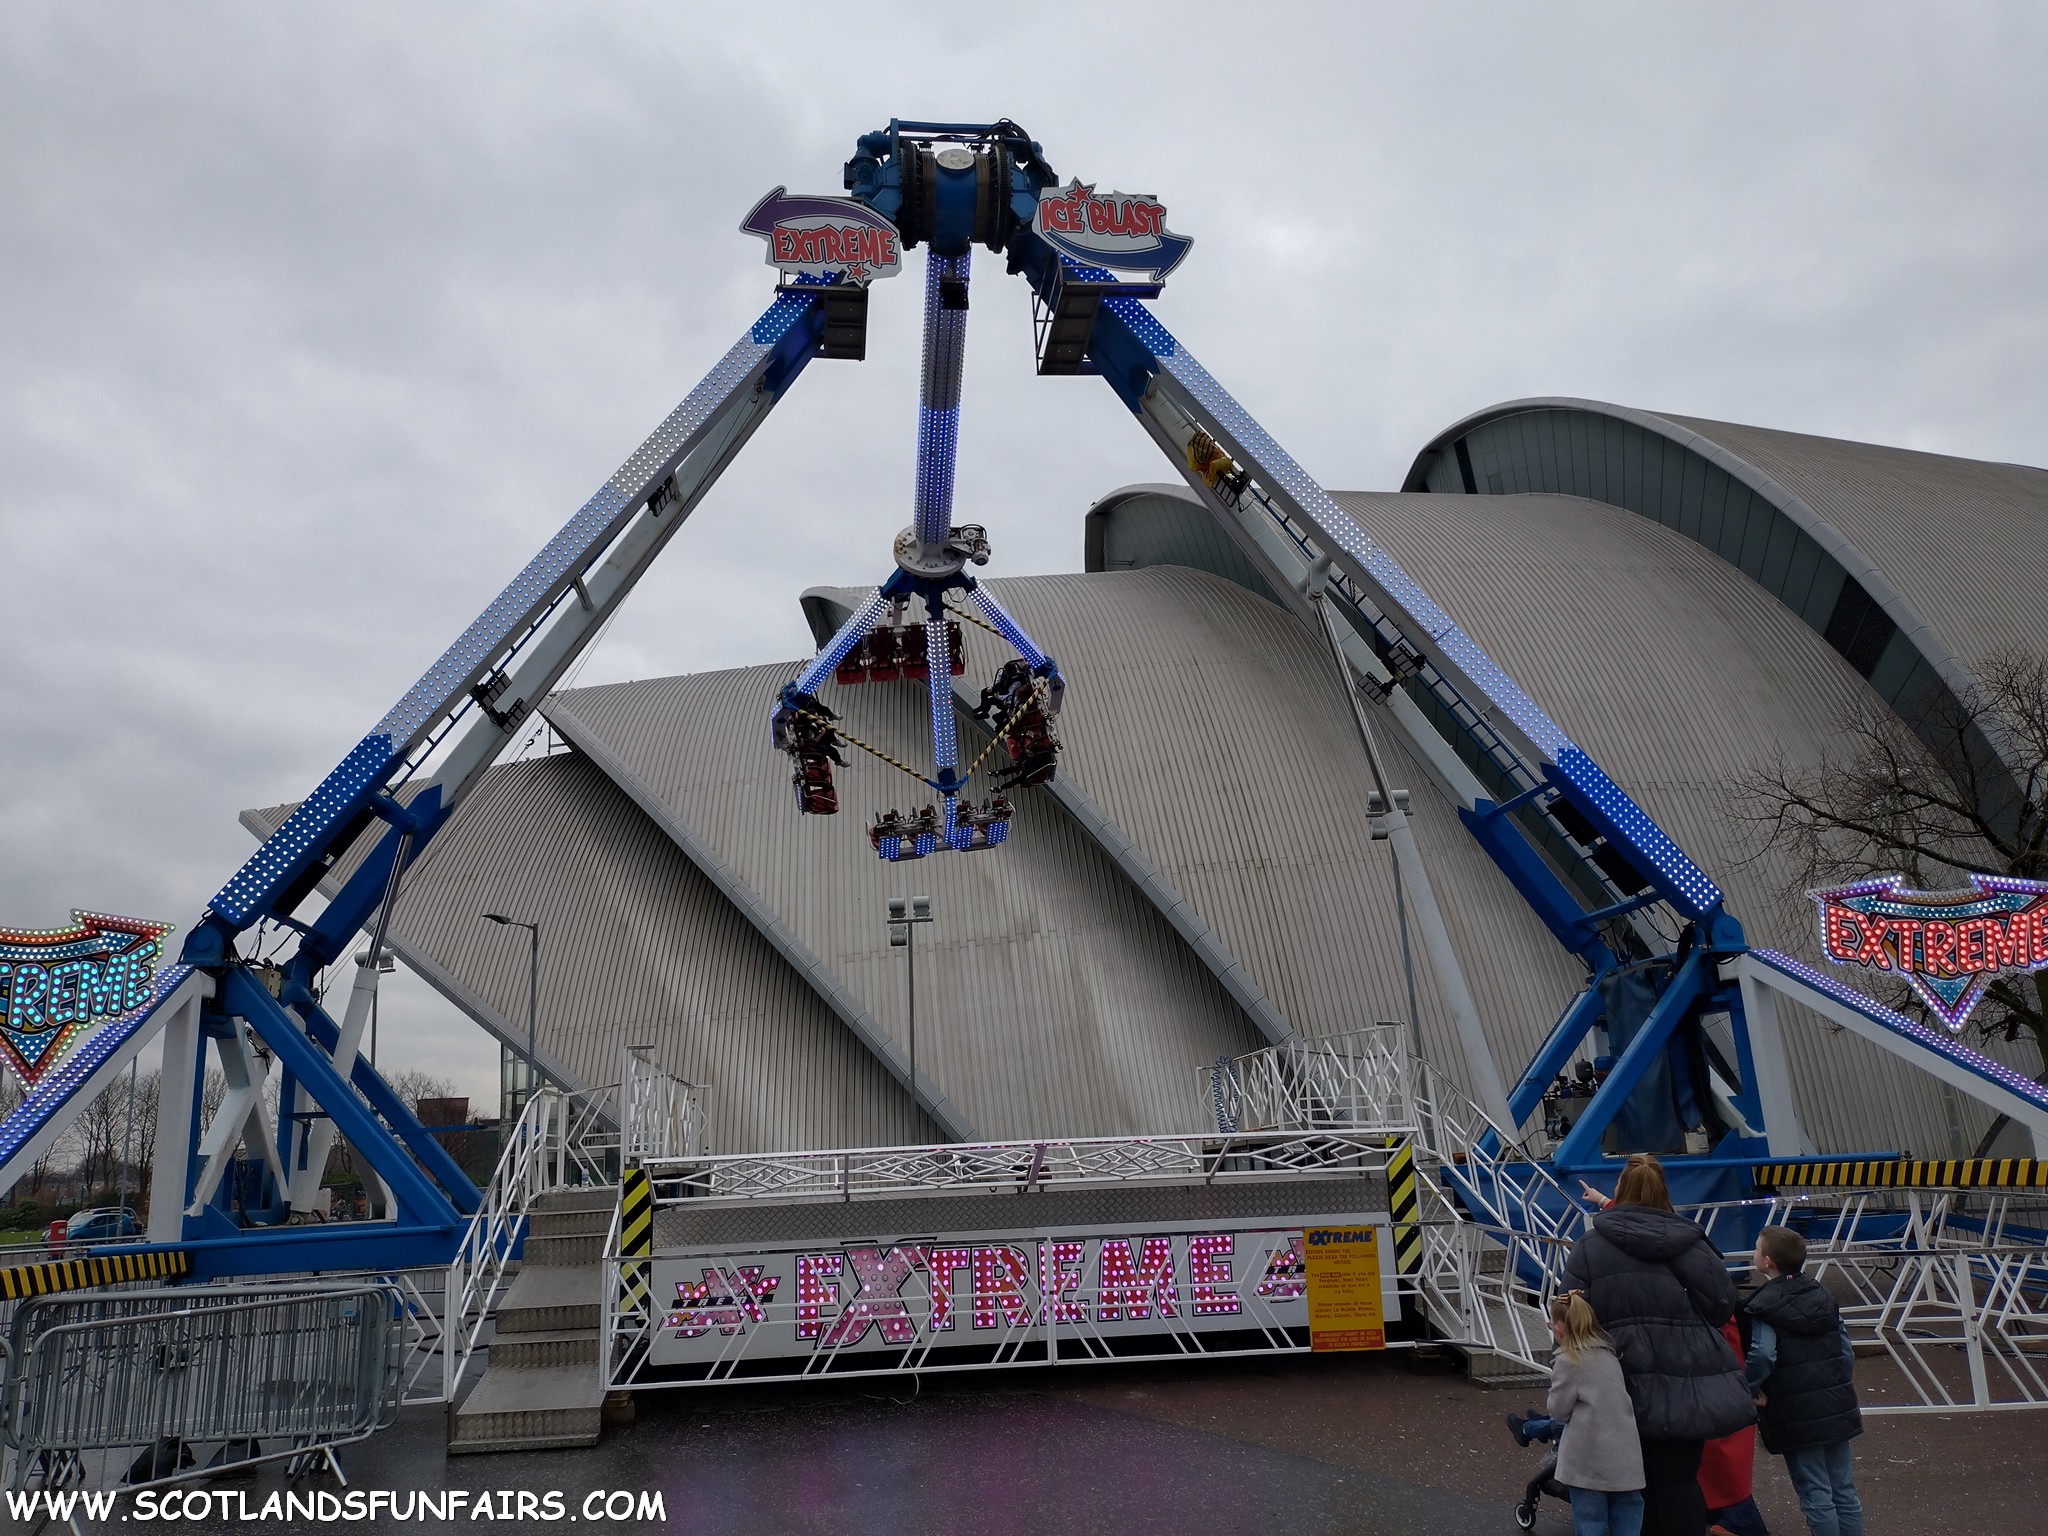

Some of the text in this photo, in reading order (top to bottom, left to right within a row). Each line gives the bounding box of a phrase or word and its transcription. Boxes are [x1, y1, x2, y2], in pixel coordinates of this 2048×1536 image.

[1040, 198, 1166, 237] ICE BLAST
[771, 225, 898, 268] EXTREME
[1825, 902, 2048, 974] EXTREME
[1308, 1230, 1372, 1246] EXTREME
[795, 1234, 1242, 1349] EXTREME
